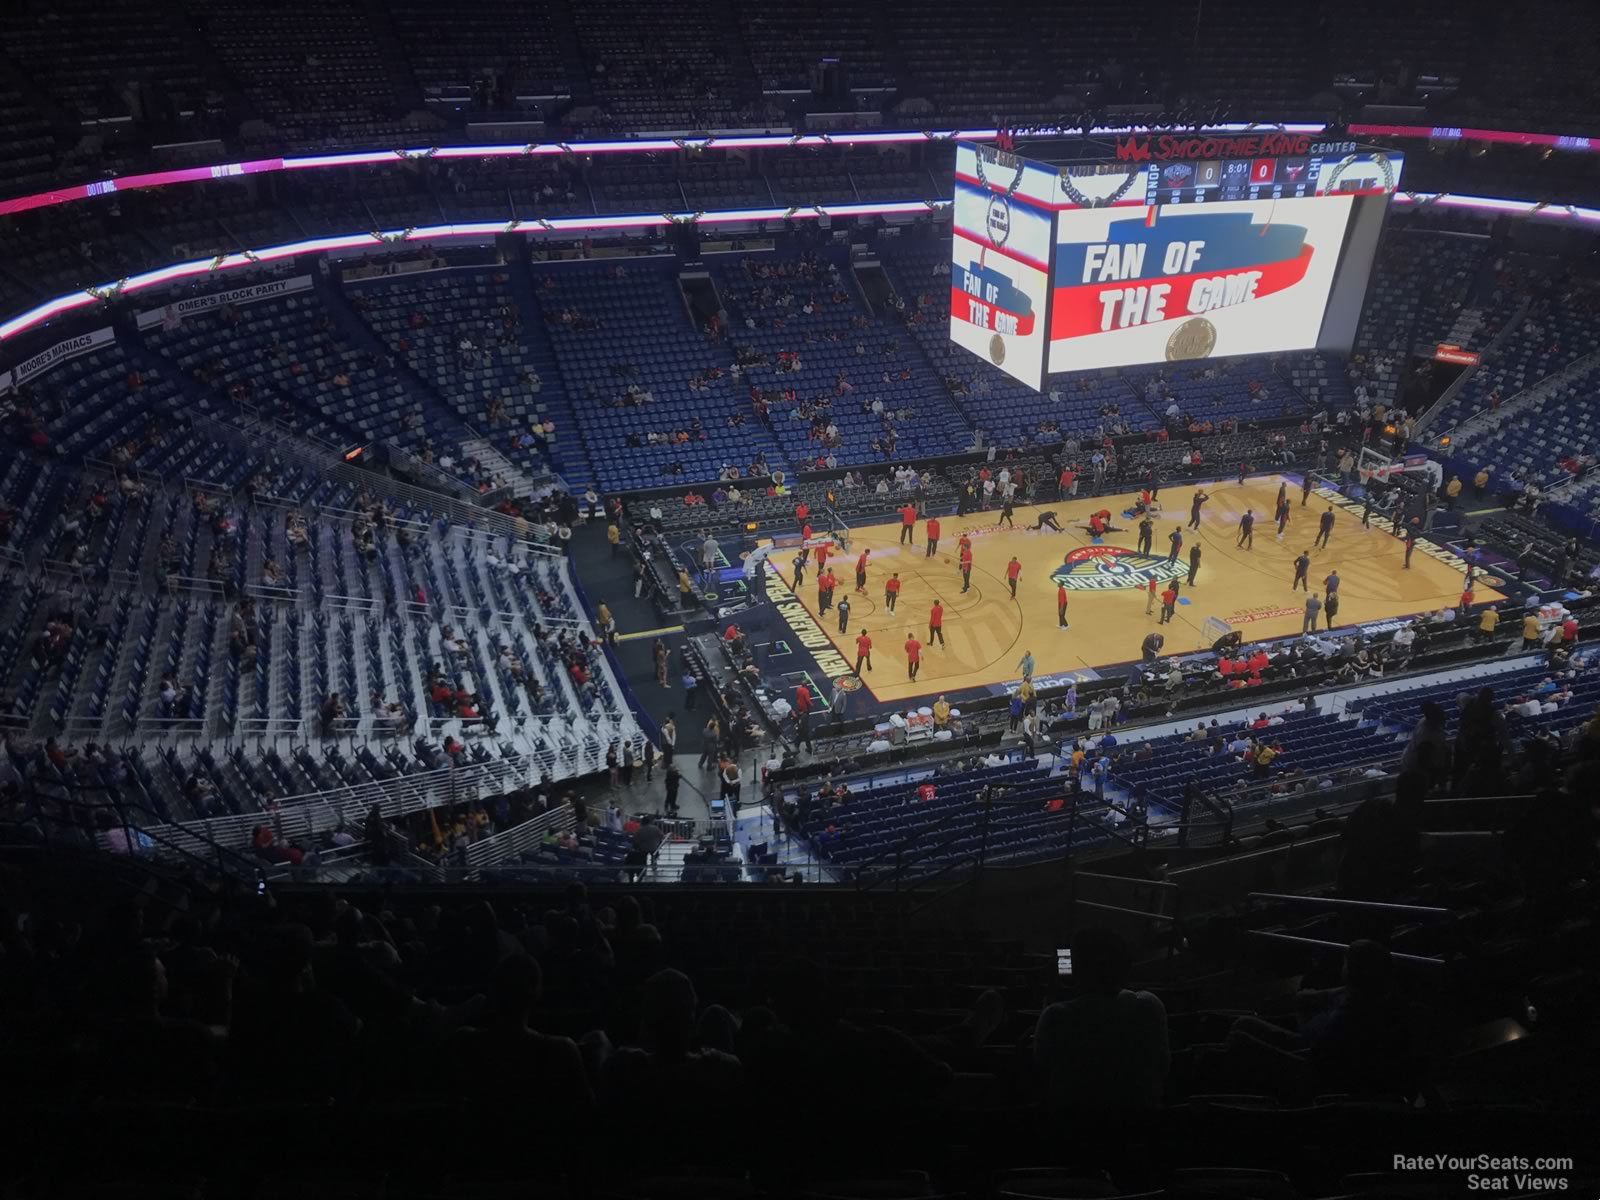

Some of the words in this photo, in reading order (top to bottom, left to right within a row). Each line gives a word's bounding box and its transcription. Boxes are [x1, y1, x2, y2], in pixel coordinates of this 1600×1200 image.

[1154, 134, 1260, 159] SMOOTHIE
[1310, 141, 1357, 154] CENTER
[1148, 164, 1160, 188] NOP
[1205, 168, 1213, 180] 0
[1228, 163, 1248, 173] 8:01
[1259, 165, 1268, 178] 0
[1308, 156, 1322, 180] CHI
[1082, 243, 1147, 283] FAN
[1162, 240, 1206, 275] OF
[178, 296, 217, 312] OMER'S
[219, 288, 254, 303] BLOCK
[255, 282, 288, 297] PARTY
[963, 270, 982, 298] FAN
[986, 282, 999, 305] OF
[1099, 283, 1172, 332] THE
[1186, 270, 1263, 315] GAME
[968, 298, 990, 329] THE
[994, 310, 1019, 336] GAME
[20, 352, 52, 376] MOORE'S
[52, 335, 93, 356] MANIACS
[776, 601, 830, 648] ORLEANS
[810, 649, 853, 678] NEW
